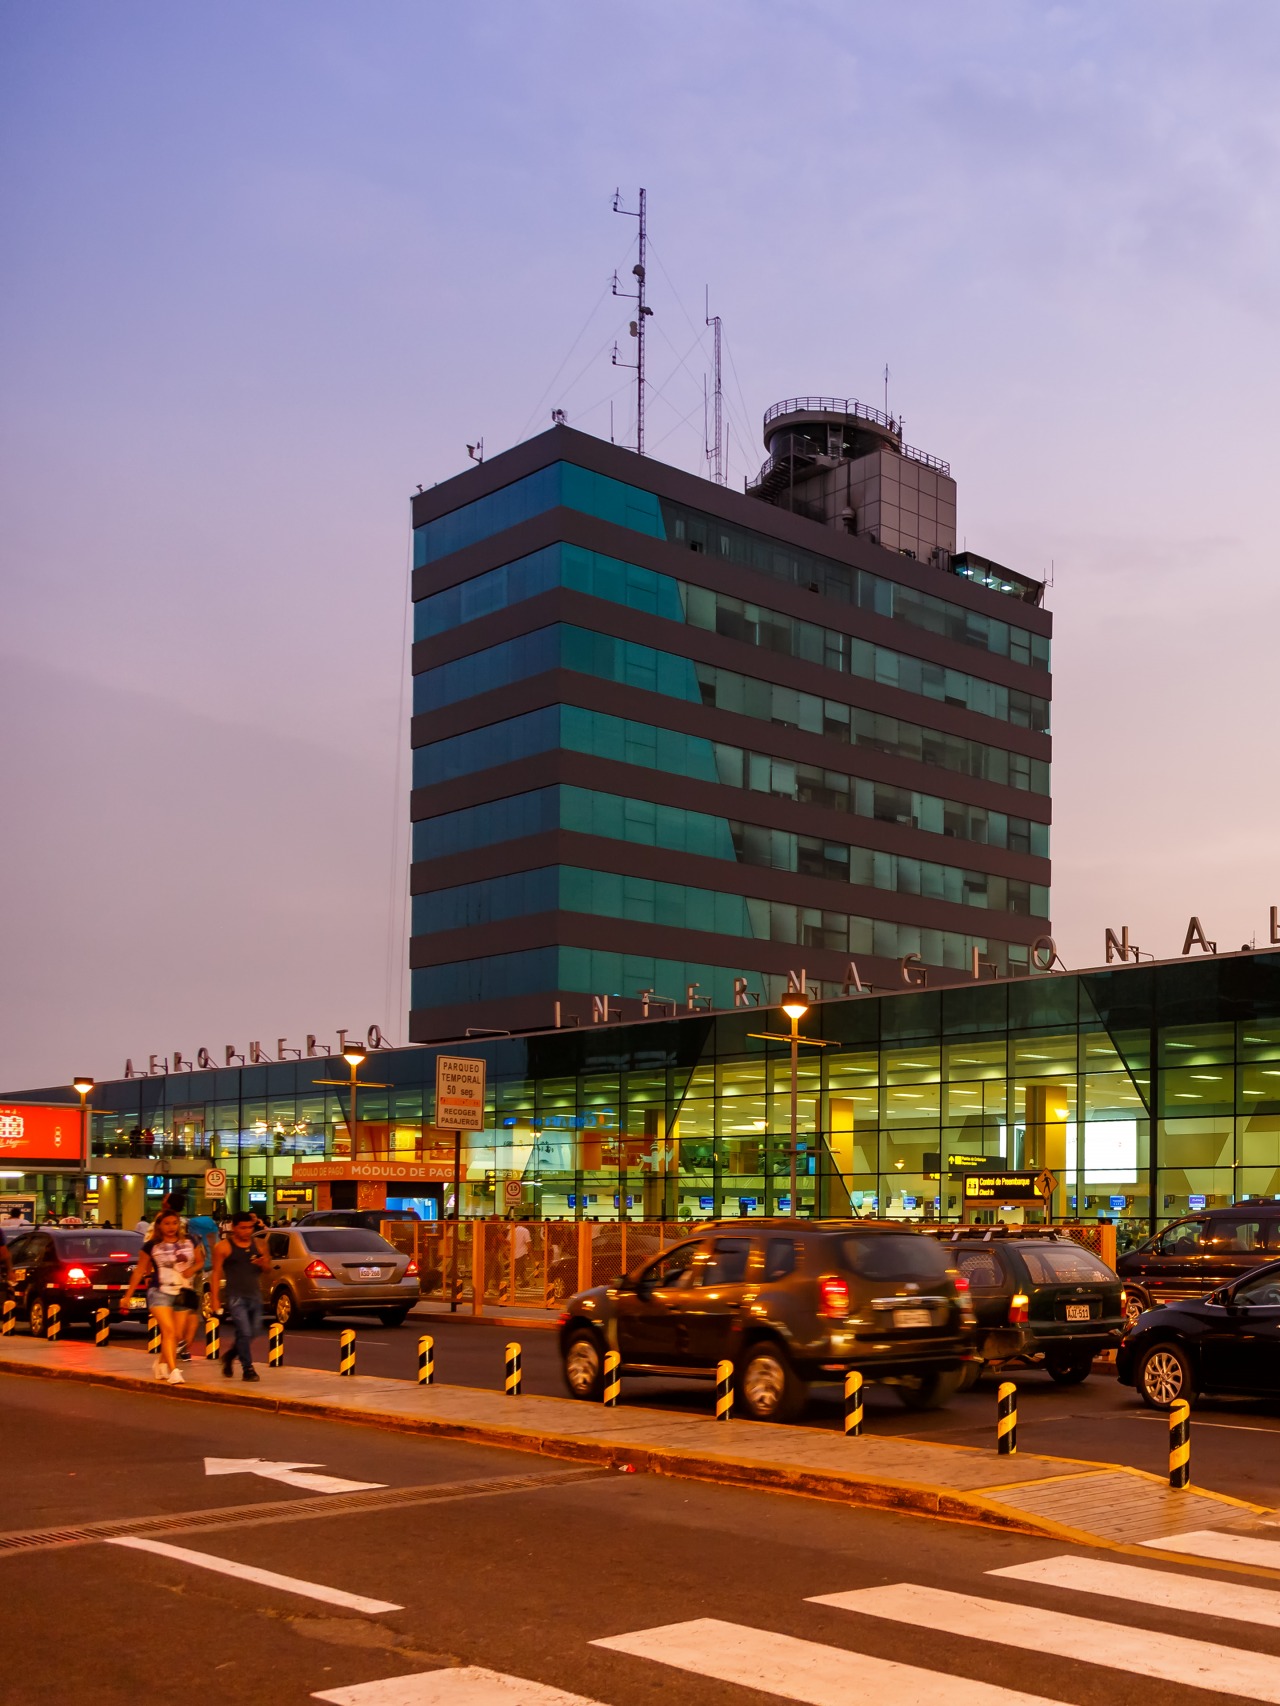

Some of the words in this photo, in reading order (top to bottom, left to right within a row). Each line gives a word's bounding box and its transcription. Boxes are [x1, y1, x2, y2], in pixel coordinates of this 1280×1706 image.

[124, 1024, 381, 1078] AEROPUERTO
[443, 1062, 480, 1073] PARQUEO
[441, 1073, 481, 1084] TEMPORAL
[446, 1085, 456, 1095] 50
[444, 1108, 476, 1116] RECOGER
[441, 1117, 479, 1126] PASAJEROS
[351, 1164, 406, 1177] MÓDULO
[409, 1167, 426, 1177] DE
[210, 1173, 221, 1181] 15
